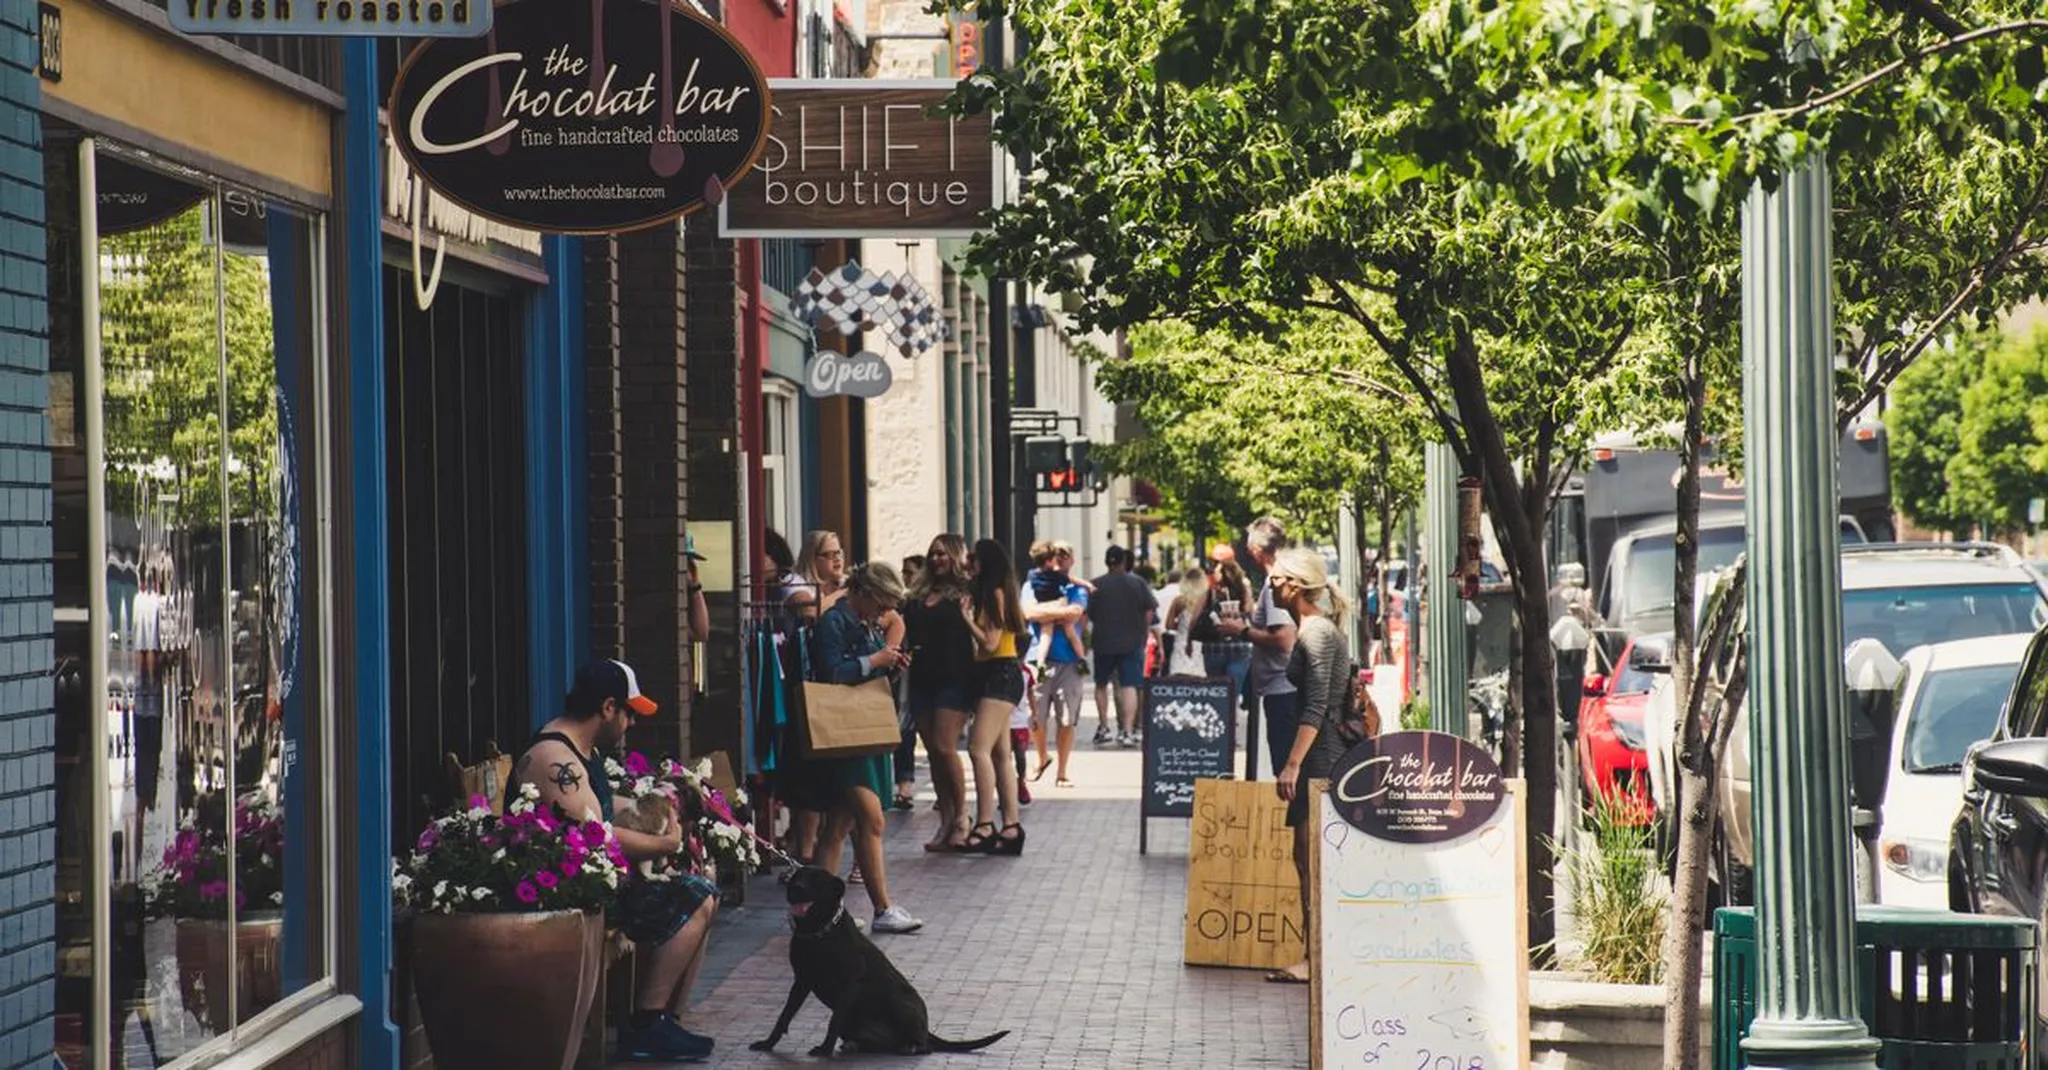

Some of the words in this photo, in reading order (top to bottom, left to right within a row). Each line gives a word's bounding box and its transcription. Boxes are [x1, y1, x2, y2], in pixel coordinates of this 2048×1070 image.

[186, 0, 291, 20] fresh
[317, 0, 470, 23] roasted
[543, 43, 589, 77] the
[409, 52, 656, 154] Chocolat
[675, 57, 751, 115] bar
[521, 128, 552, 147] fine
[558, 125, 654, 146] handcrafted
[657, 124, 739, 144] chocolates
[504, 184, 666, 202] www.thechocolatbar.com
[765, 156, 969, 217] boutique
[811, 353, 883, 394] Open
[1400, 752, 1422, 769] the
[1337, 755, 1453, 802] Chocolat
[1460, 760, 1497, 787] bar
[1197, 803, 1293, 841] SHIF
[1197, 908, 1305, 943] OPEN
[1336, 1004, 1407, 1040] Class
[1363, 1042, 1391, 1064] of
